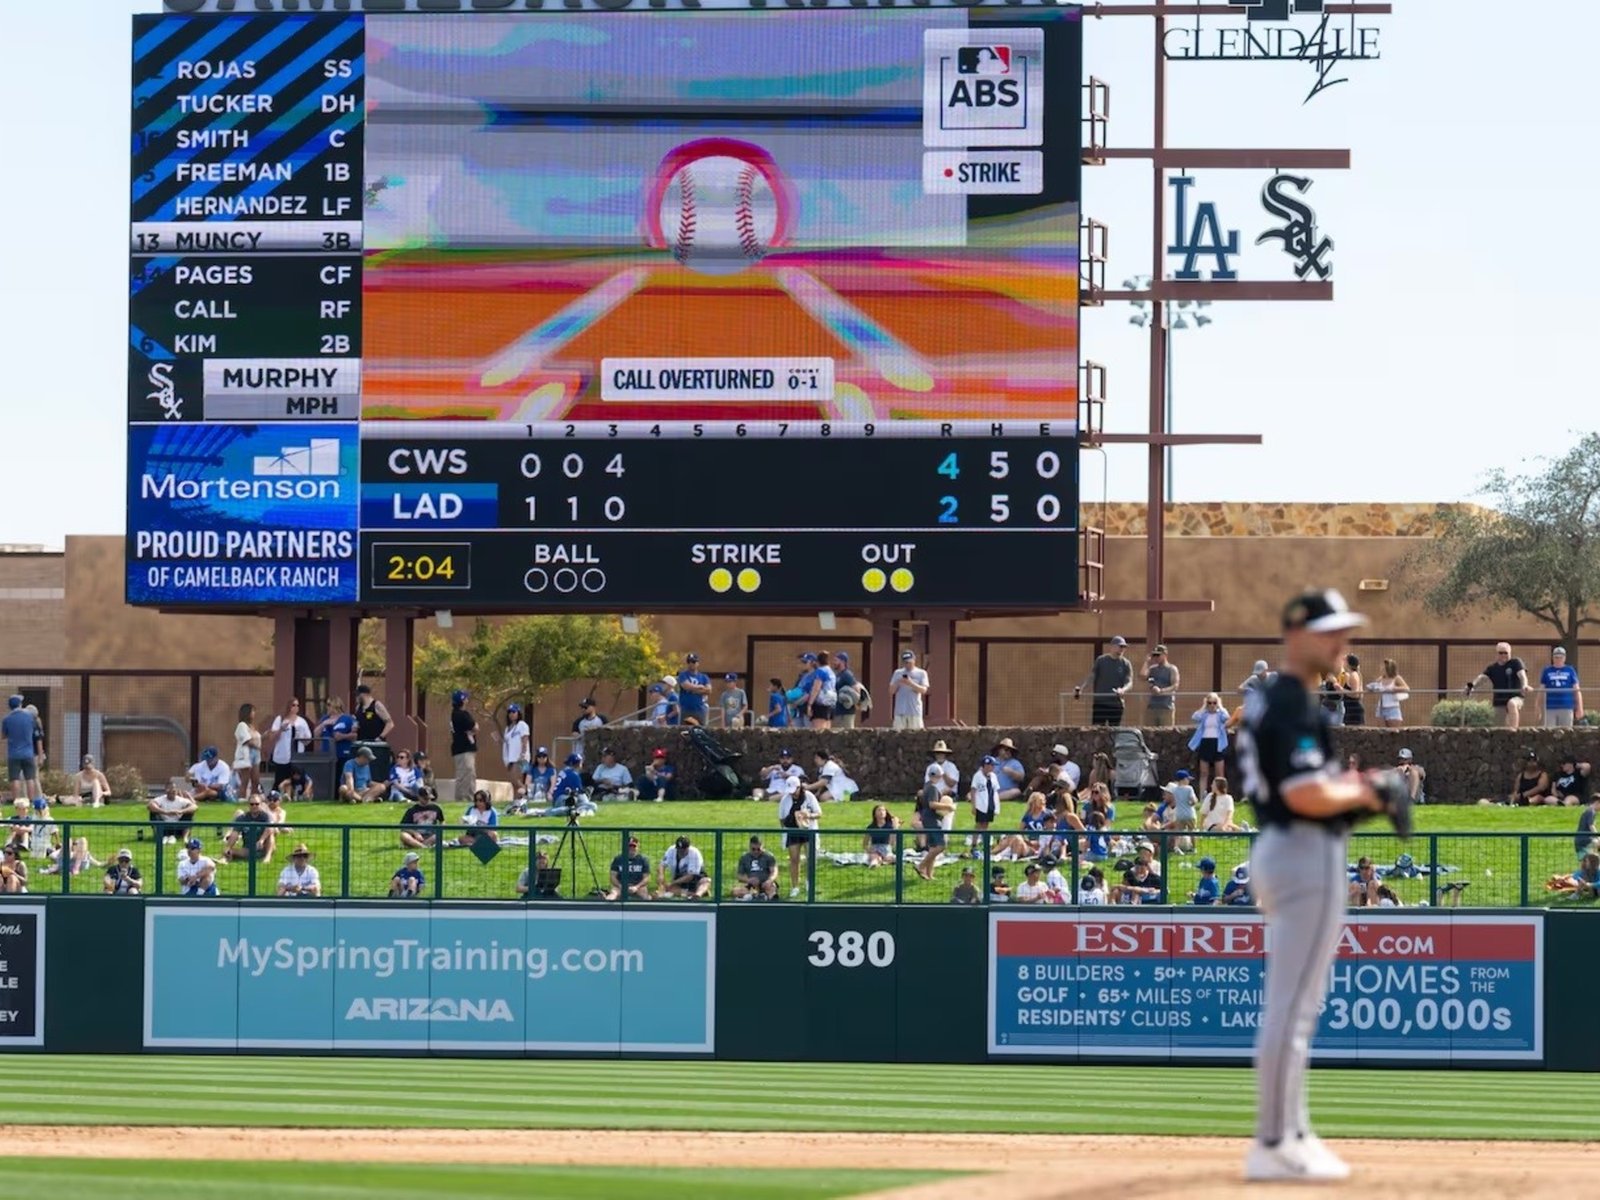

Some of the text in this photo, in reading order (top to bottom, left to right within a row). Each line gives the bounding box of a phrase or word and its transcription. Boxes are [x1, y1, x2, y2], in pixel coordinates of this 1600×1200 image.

[178, 60, 352, 79] ROJAS SS
[948, 79, 1020, 107] ABS
[177, 94, 355, 113] TUCKER DH
[176, 129, 249, 148] SMITH
[329, 129, 346, 148] C
[176, 163, 292, 182] FREEMAN
[324, 163, 350, 181] 1B
[958, 162, 1021, 183] STRIKE
[176, 196, 352, 216] HERNANDEZ LF
[137, 232, 351, 250] 13 MUNCY 3B
[175, 266, 253, 285] PAGES
[320, 266, 352, 285] CF
[175, 300, 352, 319] CALL RF
[174, 334, 217, 353] KIM
[320, 335, 350, 353] 2B
[223, 368, 338, 388] MURPHY
[614, 369, 774, 390] CALL OVERTURNED
[286, 397, 338, 415] MPH
[526, 423, 1050, 437] 1 2 3 4 5 6 7 8 9 R H E
[388, 449, 1060, 479] CWS 0 0 4 4 5 0
[141, 473, 340, 499] Mortenson
[393, 493, 1061, 523] LAD 1 1 0 2 5 0
[137, 530, 352, 558] PROUD PARTNERS
[535, 544, 600, 563] BALL
[691, 544, 781, 563] STRIKE
[861, 544, 916, 563] OUT
[148, 566, 339, 588] OF CAMELBACK RANCH
[388, 556, 454, 580] 2:04
[808, 930, 895, 967] 380
[1372, 935, 1434, 954] .COM
[217, 937, 644, 979] MySpringTraining.com
[1018, 965, 1250, 983] 8 BUILDERS 50+ PARKS
[1330, 965, 1460, 994] HOMES
[1470, 967, 1510, 979] FROM
[1018, 987, 1069, 1003] GOLF
[1098, 989, 1130, 1003] 65+
[1136, 988, 1192, 1004] MILES
[1196, 989, 1212, 999] OF
[1470, 982, 1496, 993] THE
[345, 997, 514, 1021] ARIZONA
[1018, 1009, 1126, 1026] RESIDENTS'
[1131, 1010, 1192, 1027] CLUBS
